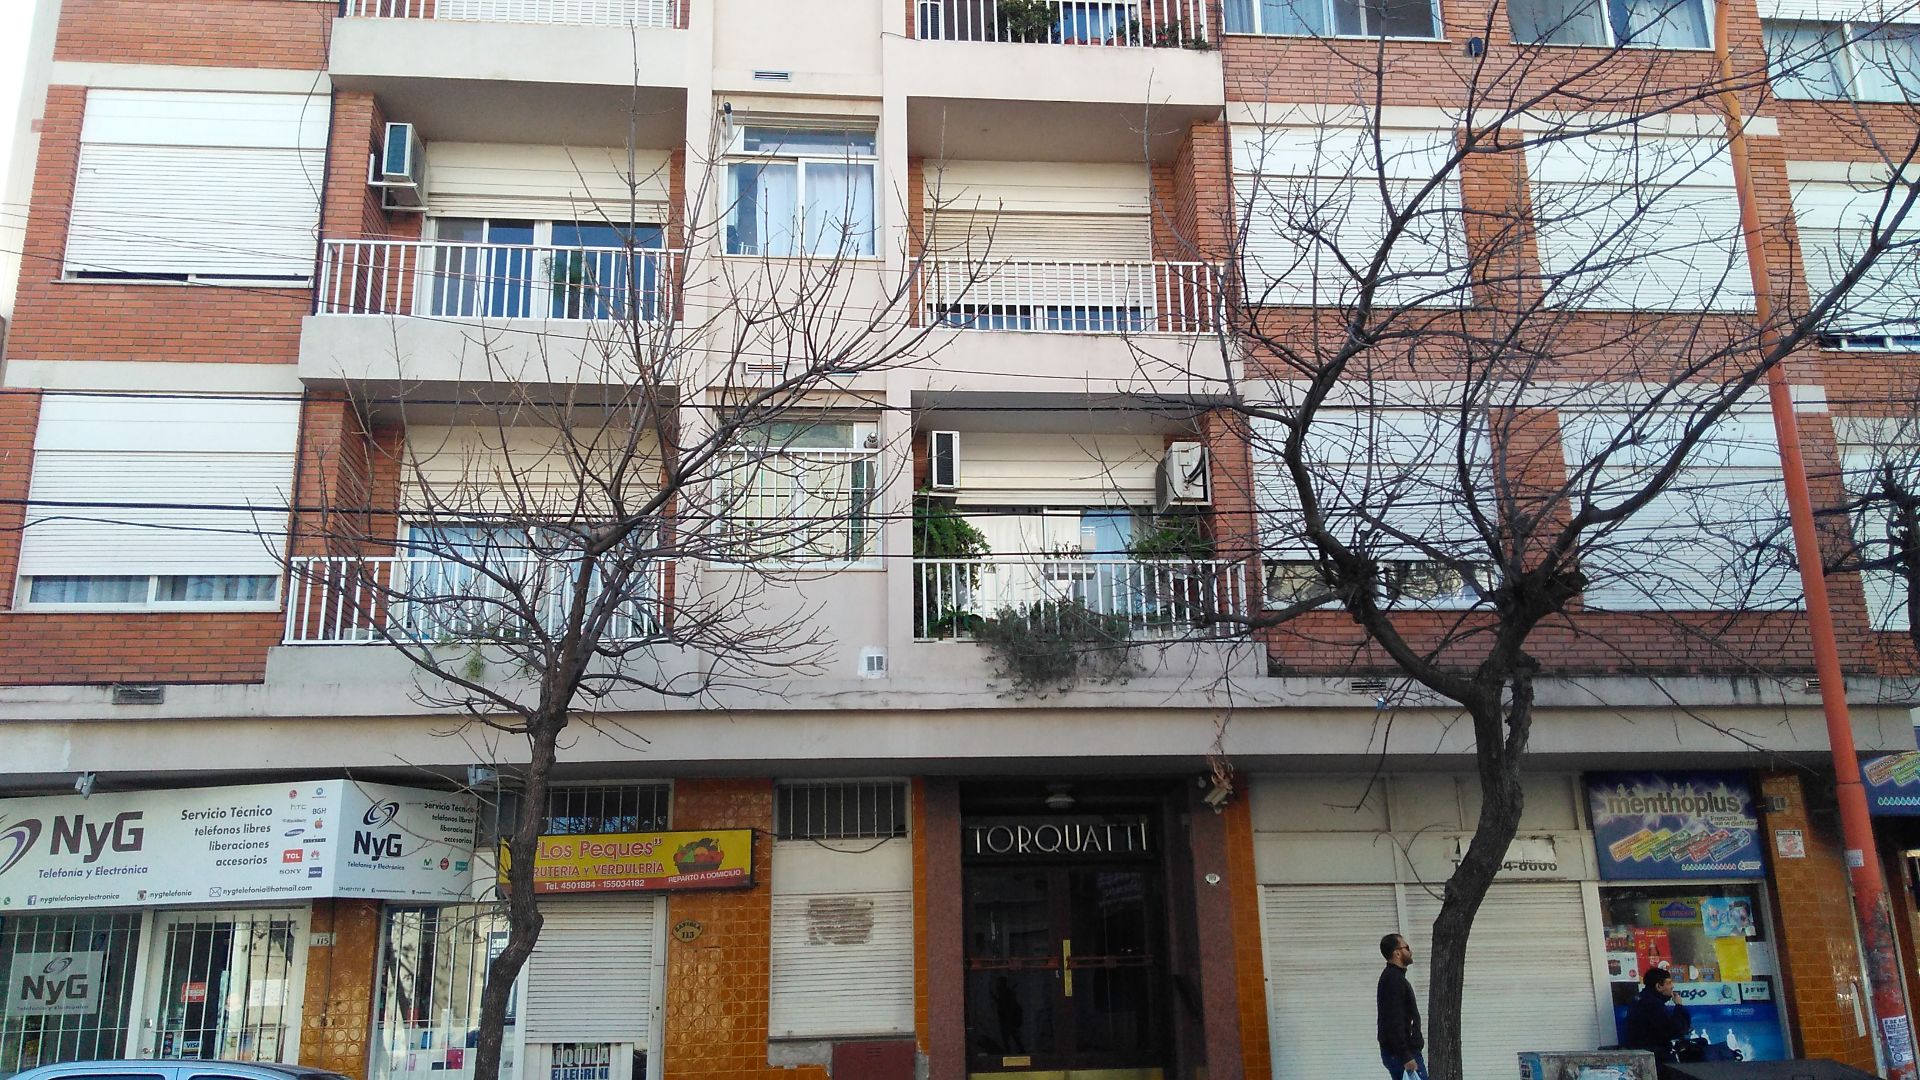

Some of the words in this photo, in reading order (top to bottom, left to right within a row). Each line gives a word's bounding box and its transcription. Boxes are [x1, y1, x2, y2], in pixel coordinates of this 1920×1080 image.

[424, 802, 450, 811] Servicio
[1609, 791, 1741, 817] menthoplus
[181, 808, 227, 820] Servicio
[230, 806, 273, 818] Técnico
[194, 825, 241, 836] teléfonos
[243, 823, 271, 834] libres
[440, 824, 473, 834] liberaciones
[50, 811, 144, 863] NyG
[968, 822, 1147, 854] TORQUATTI
[208, 839, 270, 851] liberaciones
[353, 830, 403, 861] NyG
[215, 855, 268, 866] accesorios
[38, 866, 83, 879] Telefonía
[86, 868, 93, 879] y
[95, 865, 148, 876] Electrónica
[534, 863, 580, 877] RUTERÍA
[592, 861, 665, 875] VERDULERÍA
[668, 874, 698, 883] REPARTO
[706, 869, 741, 879] DOMICILIO
[545, 882, 559, 890] Tel.
[560, 880, 596, 890] 4501884
[603, 879, 645, 888] 155034182
[316, 937, 329, 945] 115
[21, 974, 88, 1005] NyG
[551, 1067, 609, 1080] ELLEGRINI
